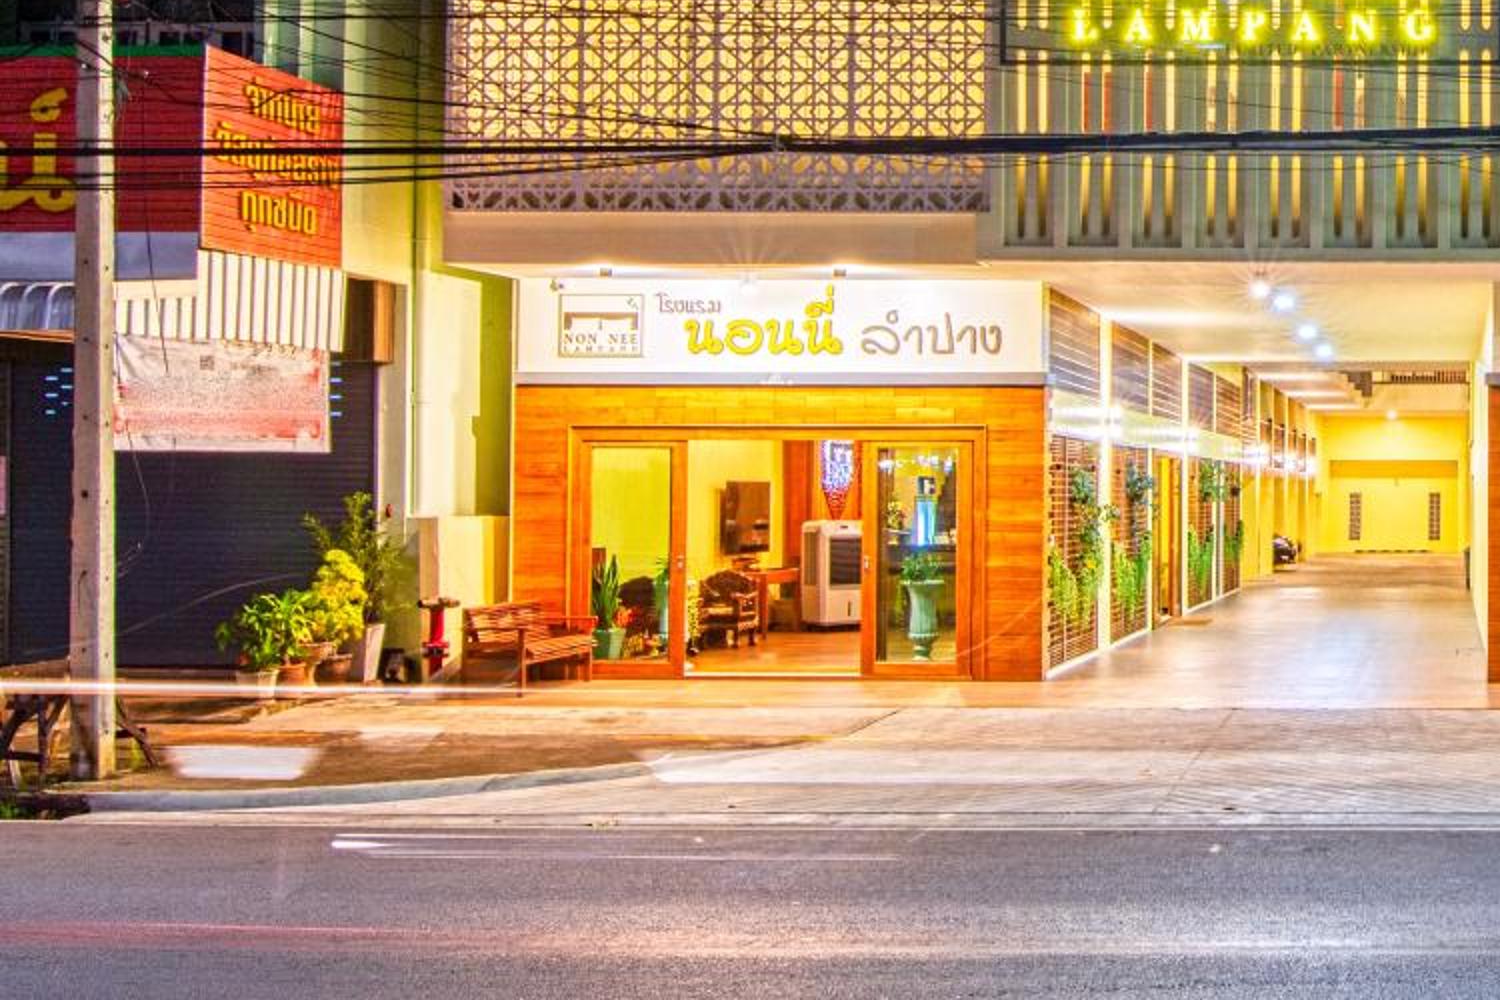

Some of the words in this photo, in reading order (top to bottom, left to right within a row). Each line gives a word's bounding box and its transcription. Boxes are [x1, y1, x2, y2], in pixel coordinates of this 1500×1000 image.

[1073, 8, 1436, 42] LAMPANG
[240, 189, 319, 235] ทุกชนิด
[655, 291, 722, 313] โรงแรม
[684, 284, 844, 356] นอนนี่
[860, 309, 1003, 356] ลำปาง
[563, 332, 598, 345] NON
[608, 332, 639, 345] NEE
